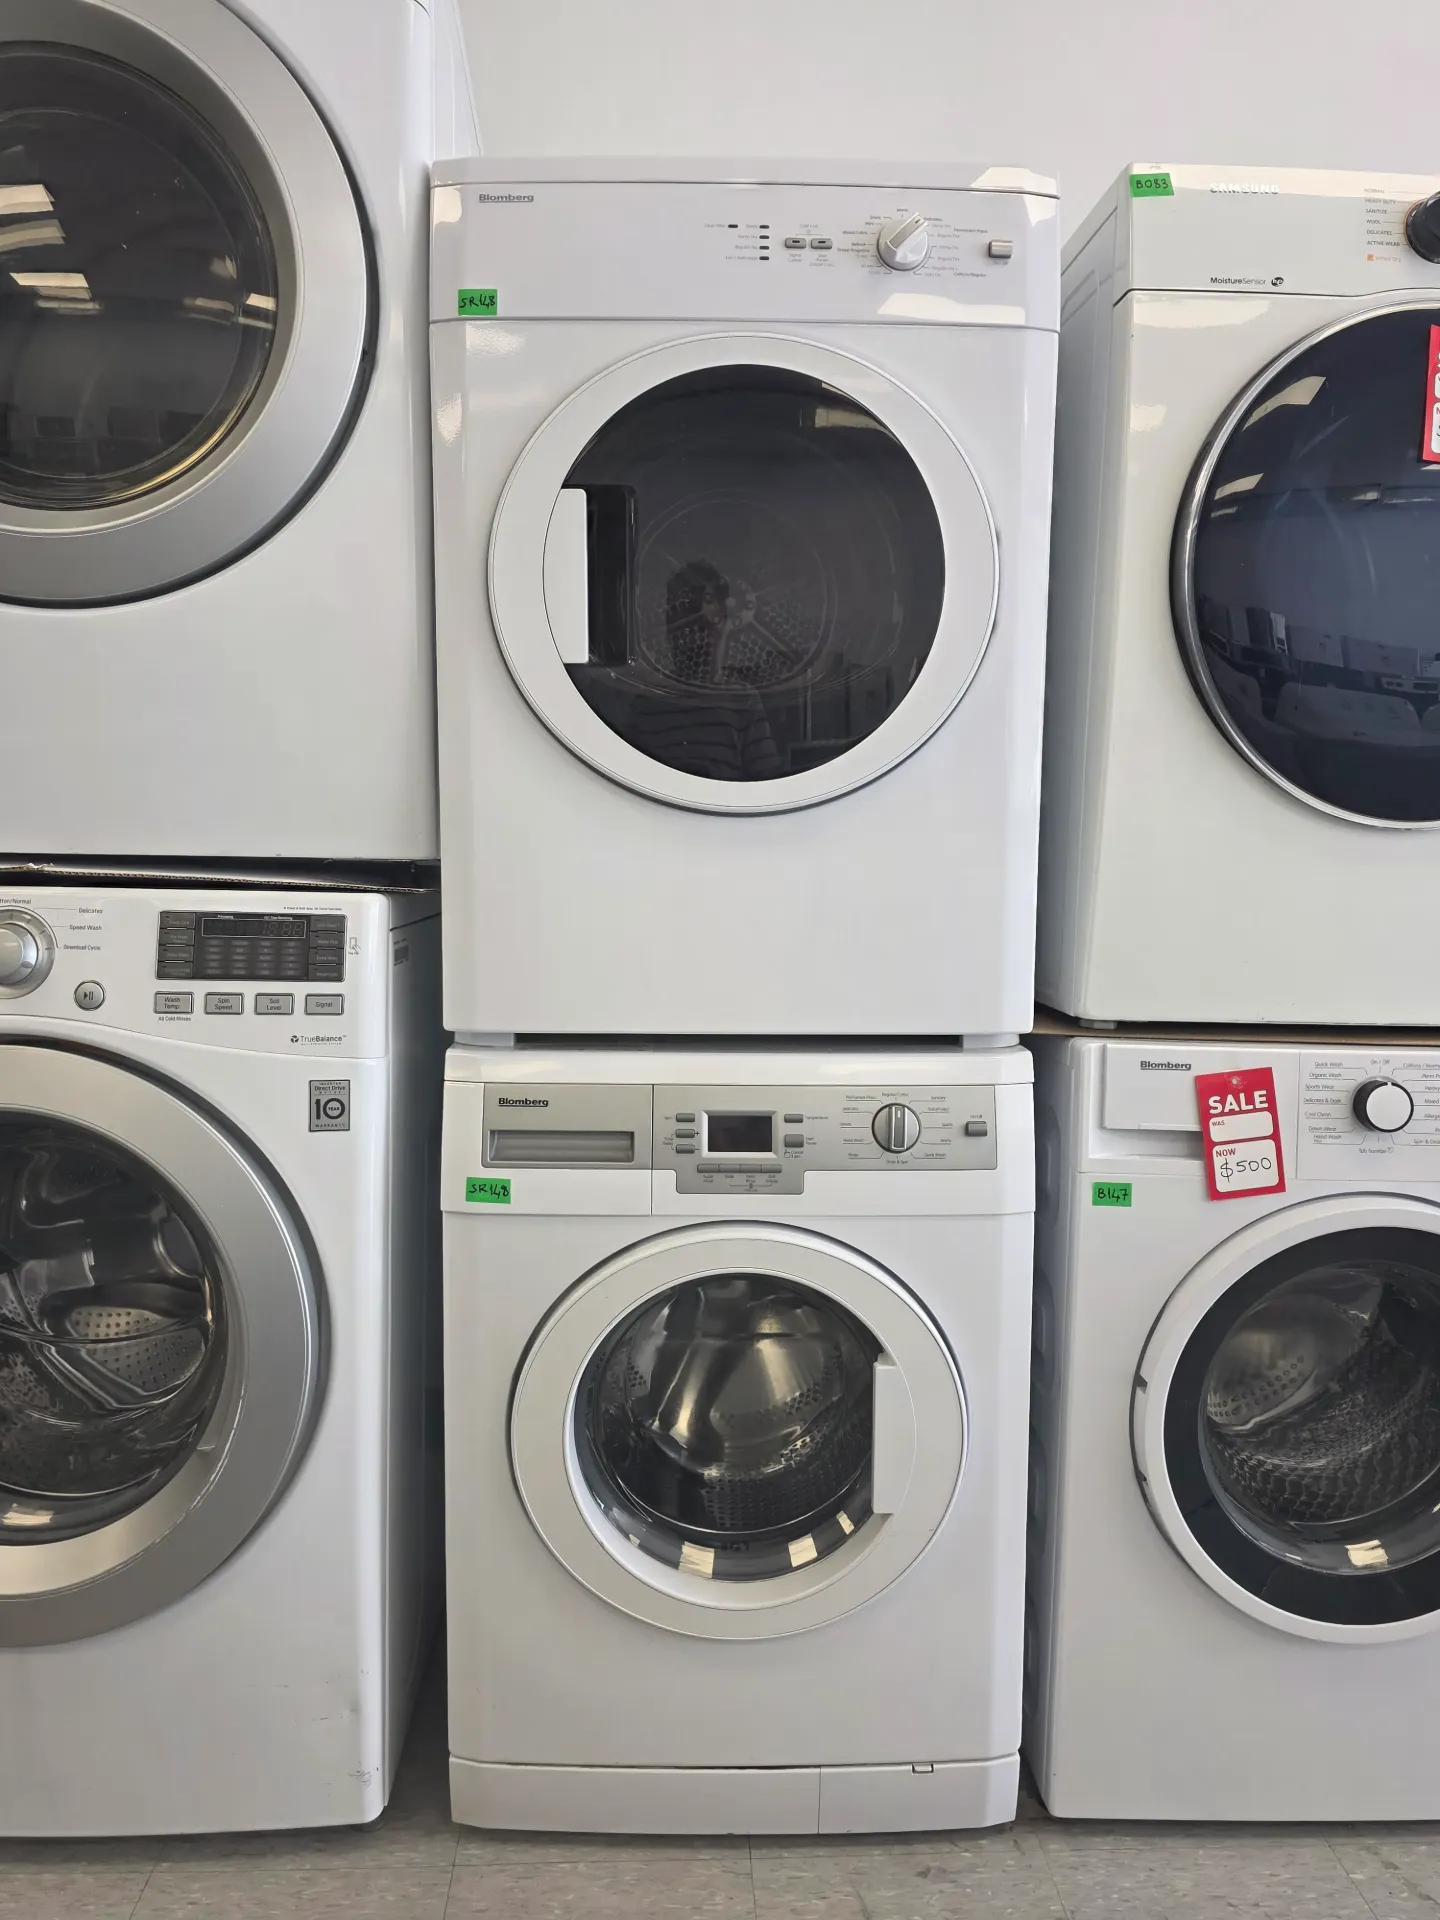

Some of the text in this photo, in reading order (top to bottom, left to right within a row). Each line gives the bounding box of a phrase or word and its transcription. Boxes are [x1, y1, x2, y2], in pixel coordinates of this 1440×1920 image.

[1135, 178, 1169, 190] B083
[1209, 182, 1280, 195] SAMSUNG
[479, 193, 535, 204] Blomberg
[1210, 276, 1267, 285] MoistureSensor
[458, 294, 496, 309] SR148
[214, 1003, 233, 1011] Speed
[315, 1001, 333, 1009] Signal
[300, 1035, 343, 1043] TrueBalance
[1140, 1060, 1192, 1071] Blomberg
[498, 1097, 549, 1108] Blomberg
[1208, 1090, 1269, 1115] SALE
[314, 1097, 346, 1120] 10
[1211, 1119, 1225, 1127] WAS
[1215, 1147, 1236, 1158] NOW
[1219, 1157, 1272, 1183] $500
[469, 1183, 510, 1200] SR148
[1097, 1187, 1130, 1203] B147
